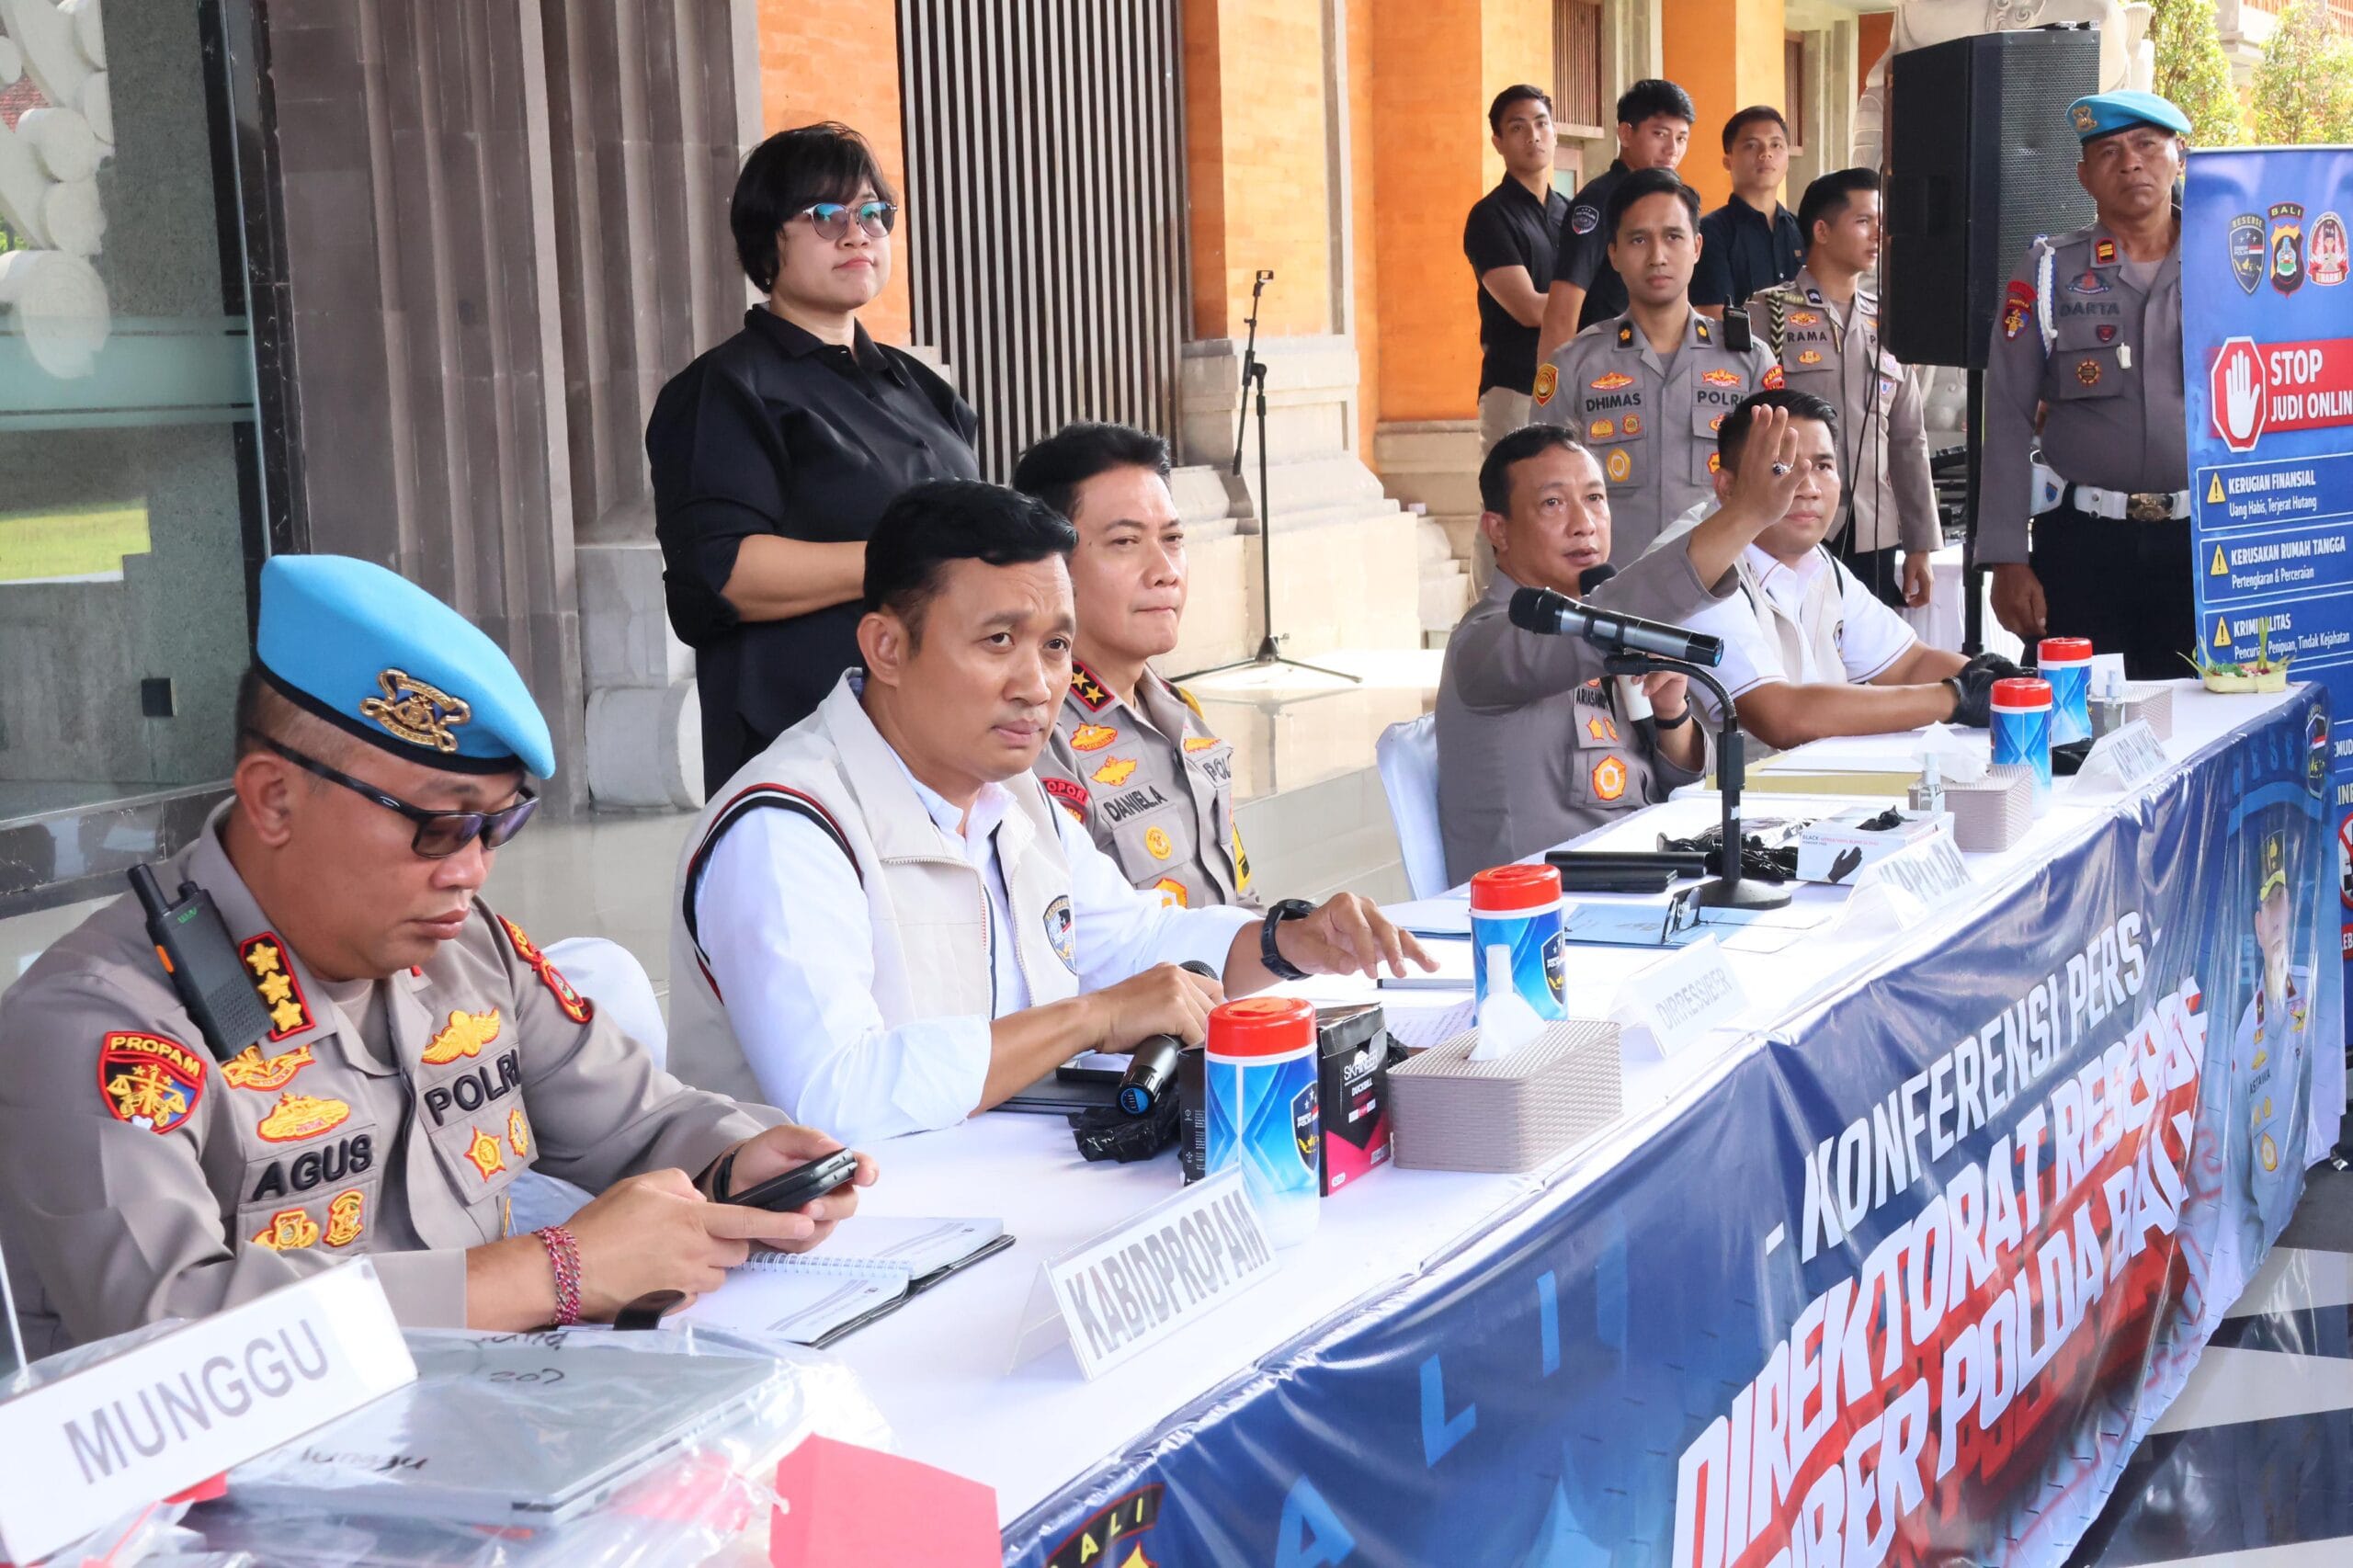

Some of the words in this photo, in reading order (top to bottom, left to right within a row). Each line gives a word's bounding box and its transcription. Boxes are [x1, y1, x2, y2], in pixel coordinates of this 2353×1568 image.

[2270, 206, 2302, 217] BALI
[1786, 331, 1828, 344] RAMA
[2270, 348, 2324, 386] STOP
[1586, 392, 1642, 413] DHIMAS
[2270, 393, 2303, 423] JUDI
[2307, 390, 2353, 419] ONLIN
[2228, 473, 2270, 494] KERUGIAN
[2271, 469, 2316, 490] FINANSIAL
[2229, 502, 2247, 520] Uang
[2248, 499, 2268, 516] Habis,
[2268, 497, 2292, 516] Terjerat
[2292, 495, 2317, 511] Hutang
[2231, 544, 2279, 566] KERUSAKAN
[2280, 539, 2311, 560] RUMAH
[2312, 535, 2347, 555] TANGGA
[2232, 571, 2274, 590] Pertengkaran
[2274, 568, 2279, 583] &
[2280, 564, 2314, 581] Perceraian
[2234, 613, 2291, 638] KRIMILITAS
[2234, 642, 2268, 660] Pencuria,
[2268, 639, 2297, 656] Penipuan,
[2298, 633, 2320, 651] Tindak
[2320, 630, 2350, 649] Kejahatan
[1046, 781, 1086, 802] OPOR
[1103, 785, 1169, 823] DANIEL.A
[109, 1035, 201, 1078] PROPAM
[423, 1048, 522, 1127] POLRI
[1802, 972, 2061, 1265] KONFERENSI
[2065, 910, 2145, 1049] PERS
[251, 1133, 374, 1202] AGUS
[1064, 1188, 1272, 1361] KABIDPROPAM
[1671, 1103, 2048, 1568] DIREKTORAT
[62, 1317, 329, 1485] MUNGGU
[1767, 1376, 1929, 1568] IBER
[1936, 1199, 2105, 1483] POLDA
[1051, 1497, 1143, 1568] ALI
